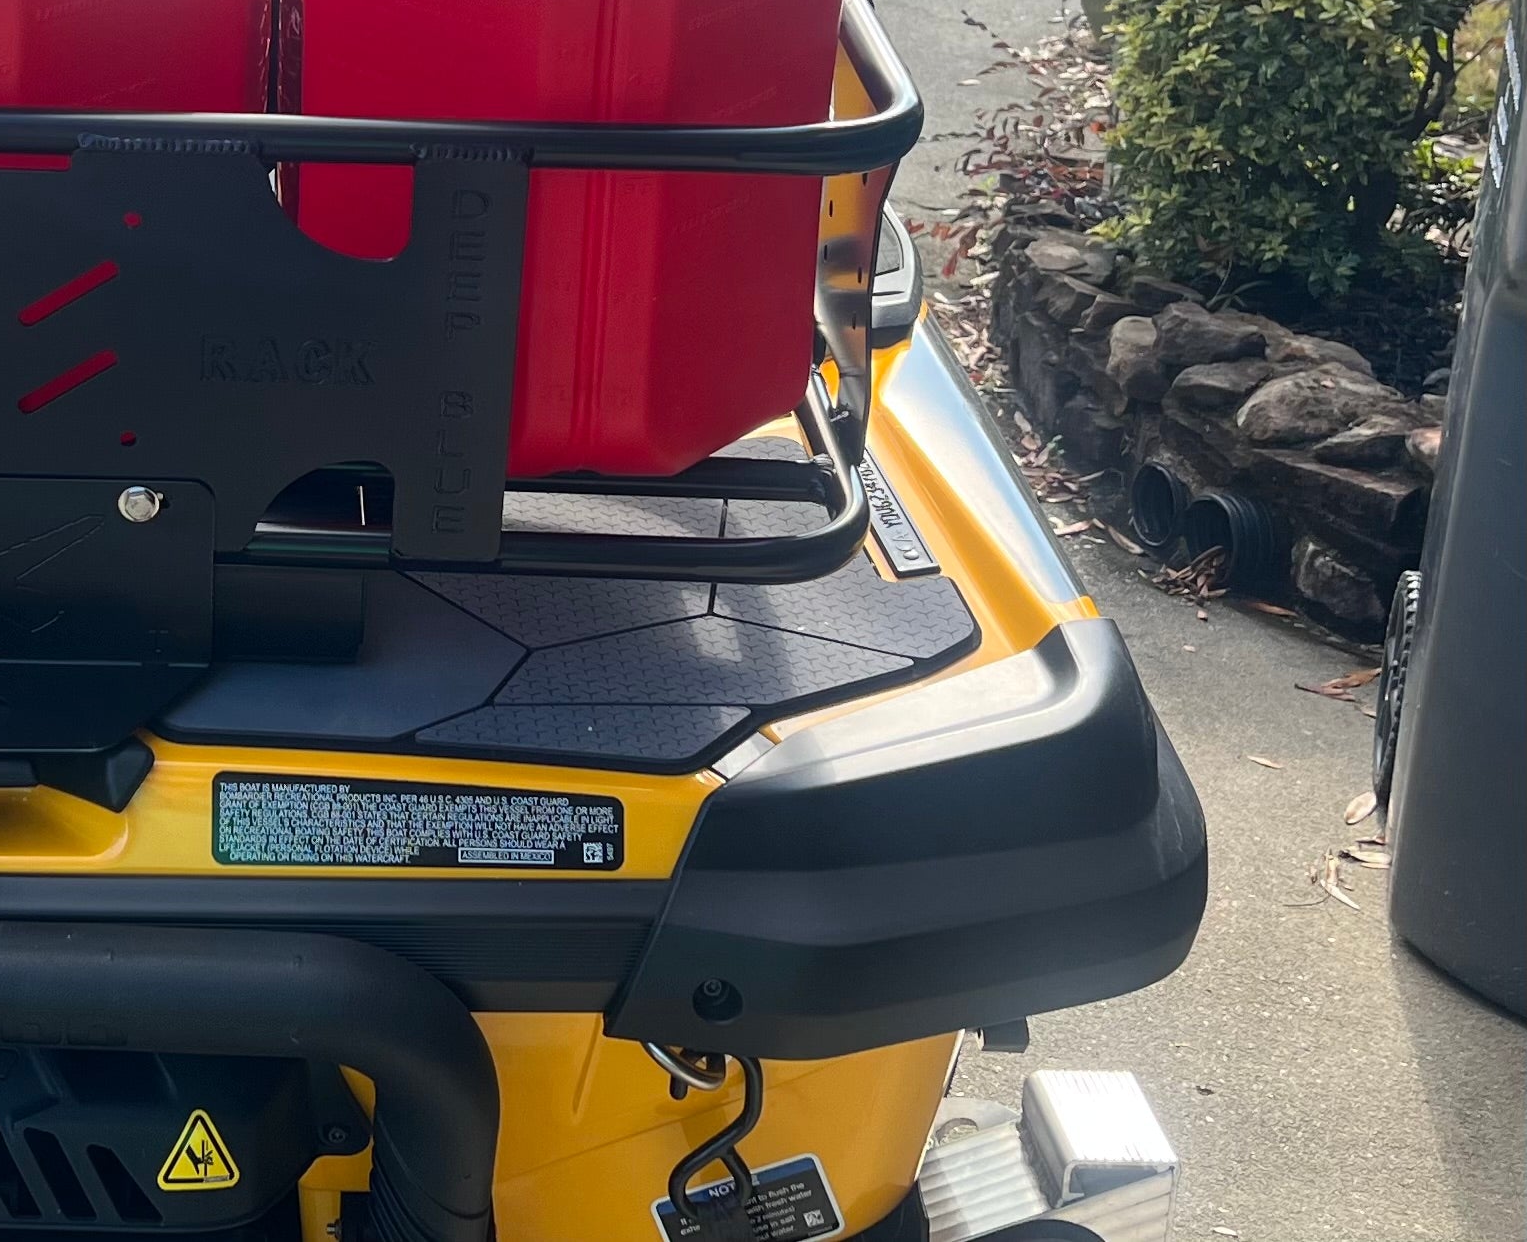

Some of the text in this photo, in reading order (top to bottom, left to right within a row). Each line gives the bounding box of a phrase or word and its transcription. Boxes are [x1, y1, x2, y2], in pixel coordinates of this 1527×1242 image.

[199, 334, 377, 384] RACK
[220, 783, 237, 792] THIS
[240, 783, 260, 792] BOAT
[272, 784, 337, 793] MANUFACTURED
[339, 784, 350, 793] BY
[336, 794, 381, 803] PRODUCTS
[400, 795, 417, 804] PER
[475, 796, 492, 805] AND
[511, 797, 538, 806] COAST
[540, 798, 569, 806] GUARD
[379, 803, 406, 812] COAST
[575, 806, 587, 815] OR
[495, 822, 512, 832] NOT
[514, 823, 535, 832] HAVE
[588, 824, 618, 834] EFFECT
[386, 829, 408, 838] BOAT
[492, 831, 519, 840] COAST
[520, 832, 550, 840] GUARD
[552, 832, 582, 841] SAFETY
[343, 837, 364, 846] DATE
[458, 839, 498, 848] PERSONS
[500, 840, 533, 849] SHOULD
[534, 840, 559, 849] WEAR
